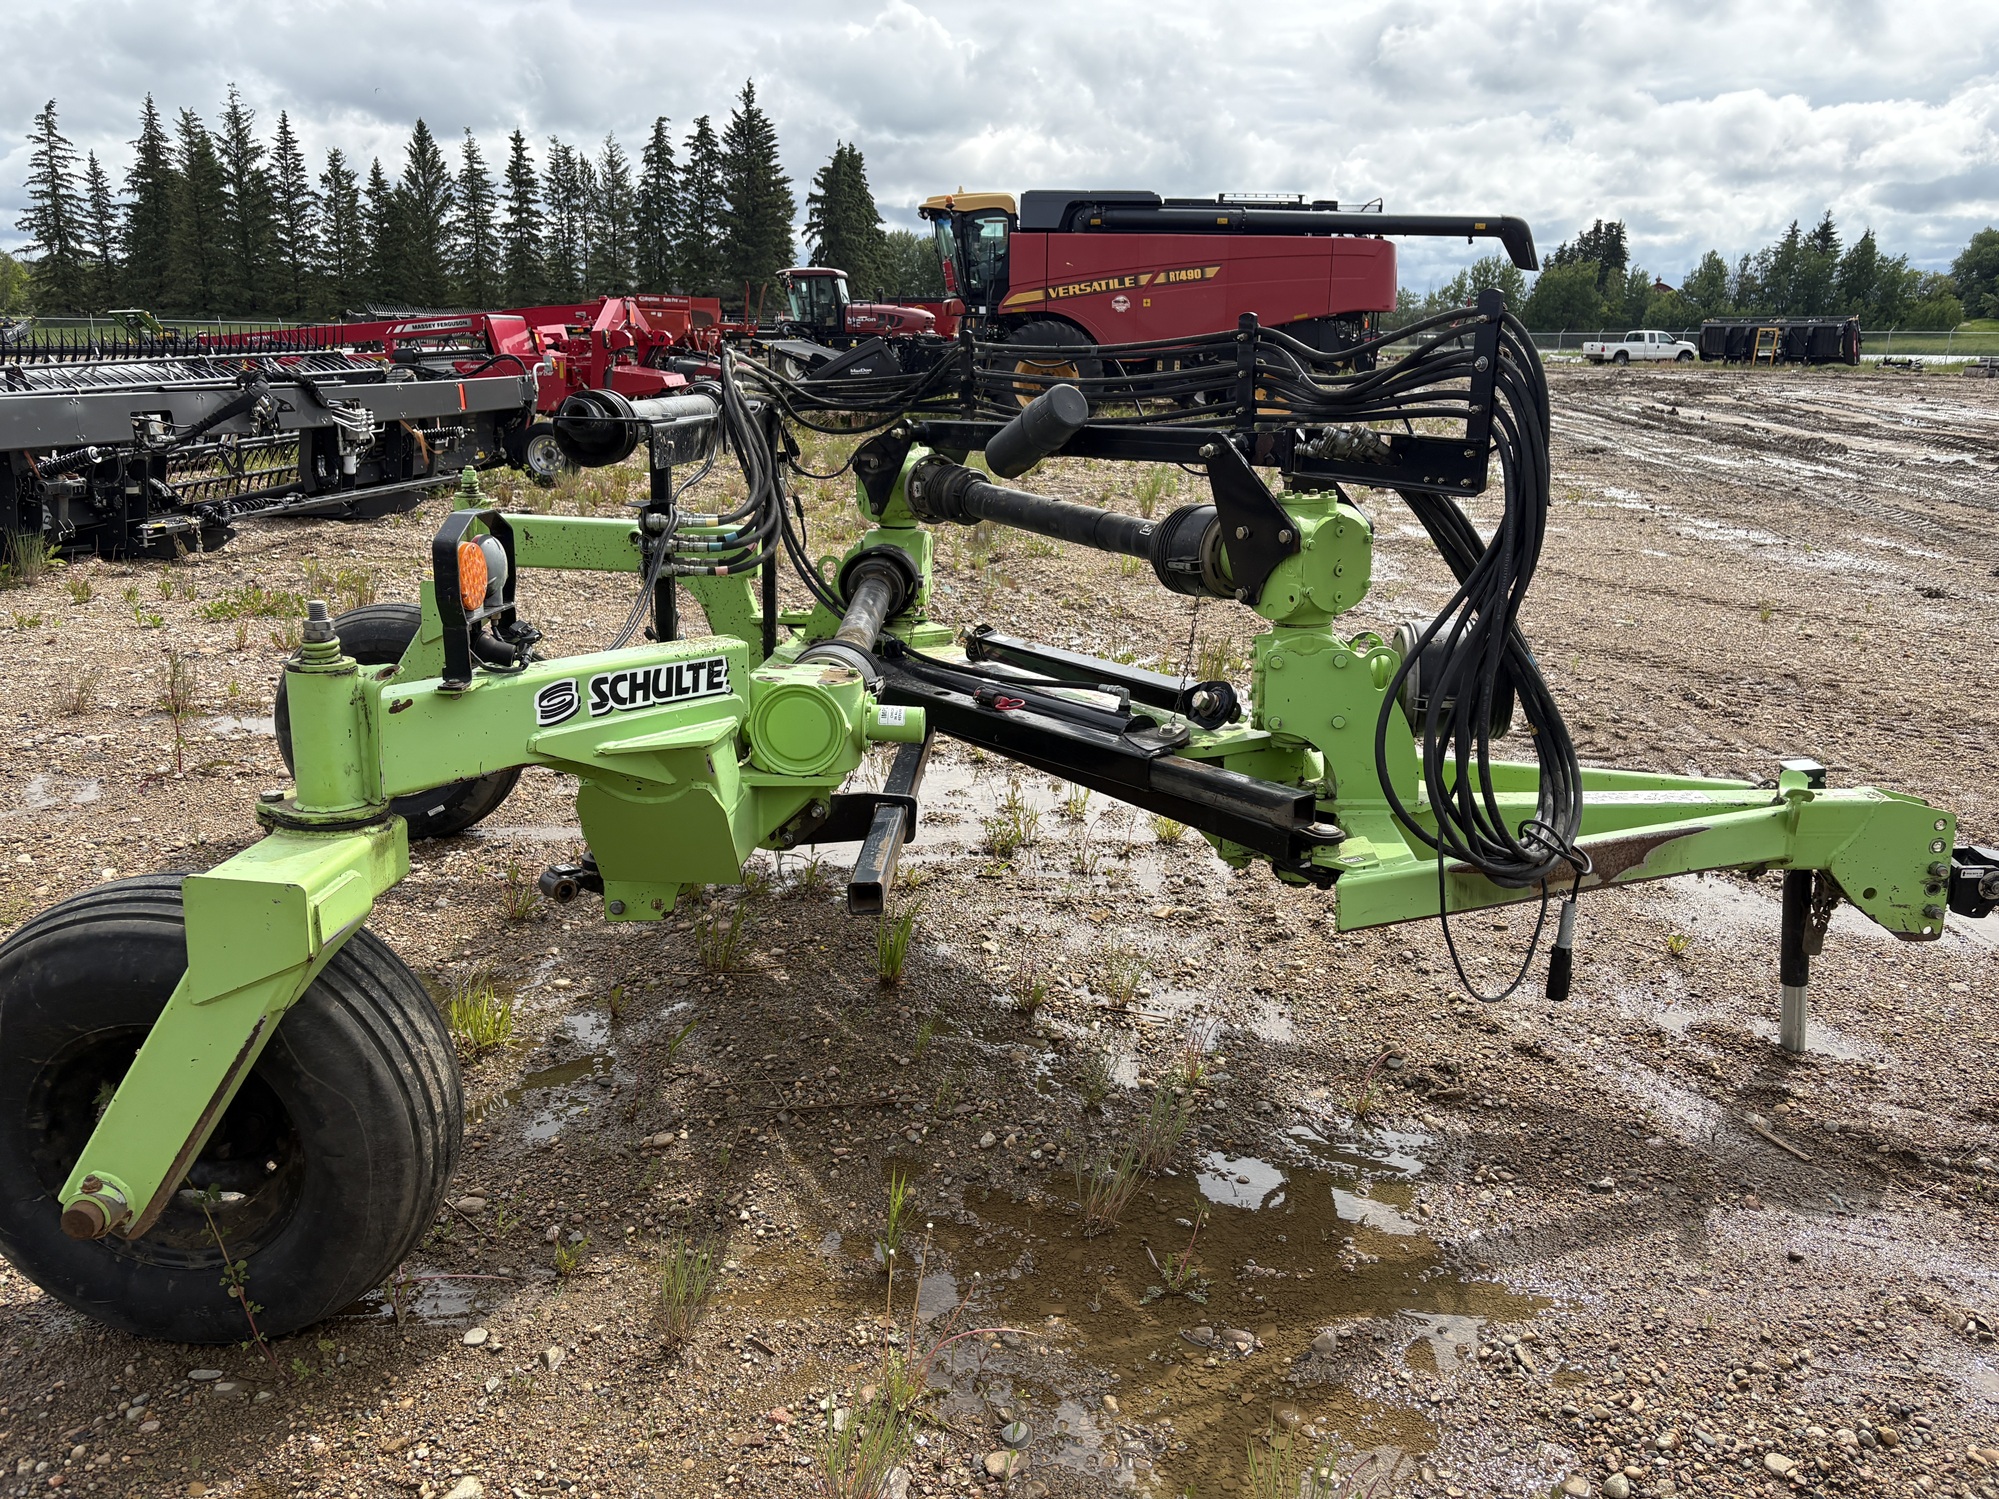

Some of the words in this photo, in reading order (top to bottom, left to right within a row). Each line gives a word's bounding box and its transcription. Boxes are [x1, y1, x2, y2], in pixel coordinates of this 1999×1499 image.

[1169, 268, 1202, 282] RT490
[1048, 276, 1135, 298] VERSATILE
[436, 320, 468, 328] FERGUSON
[590, 657, 726, 713] SCHULTE
